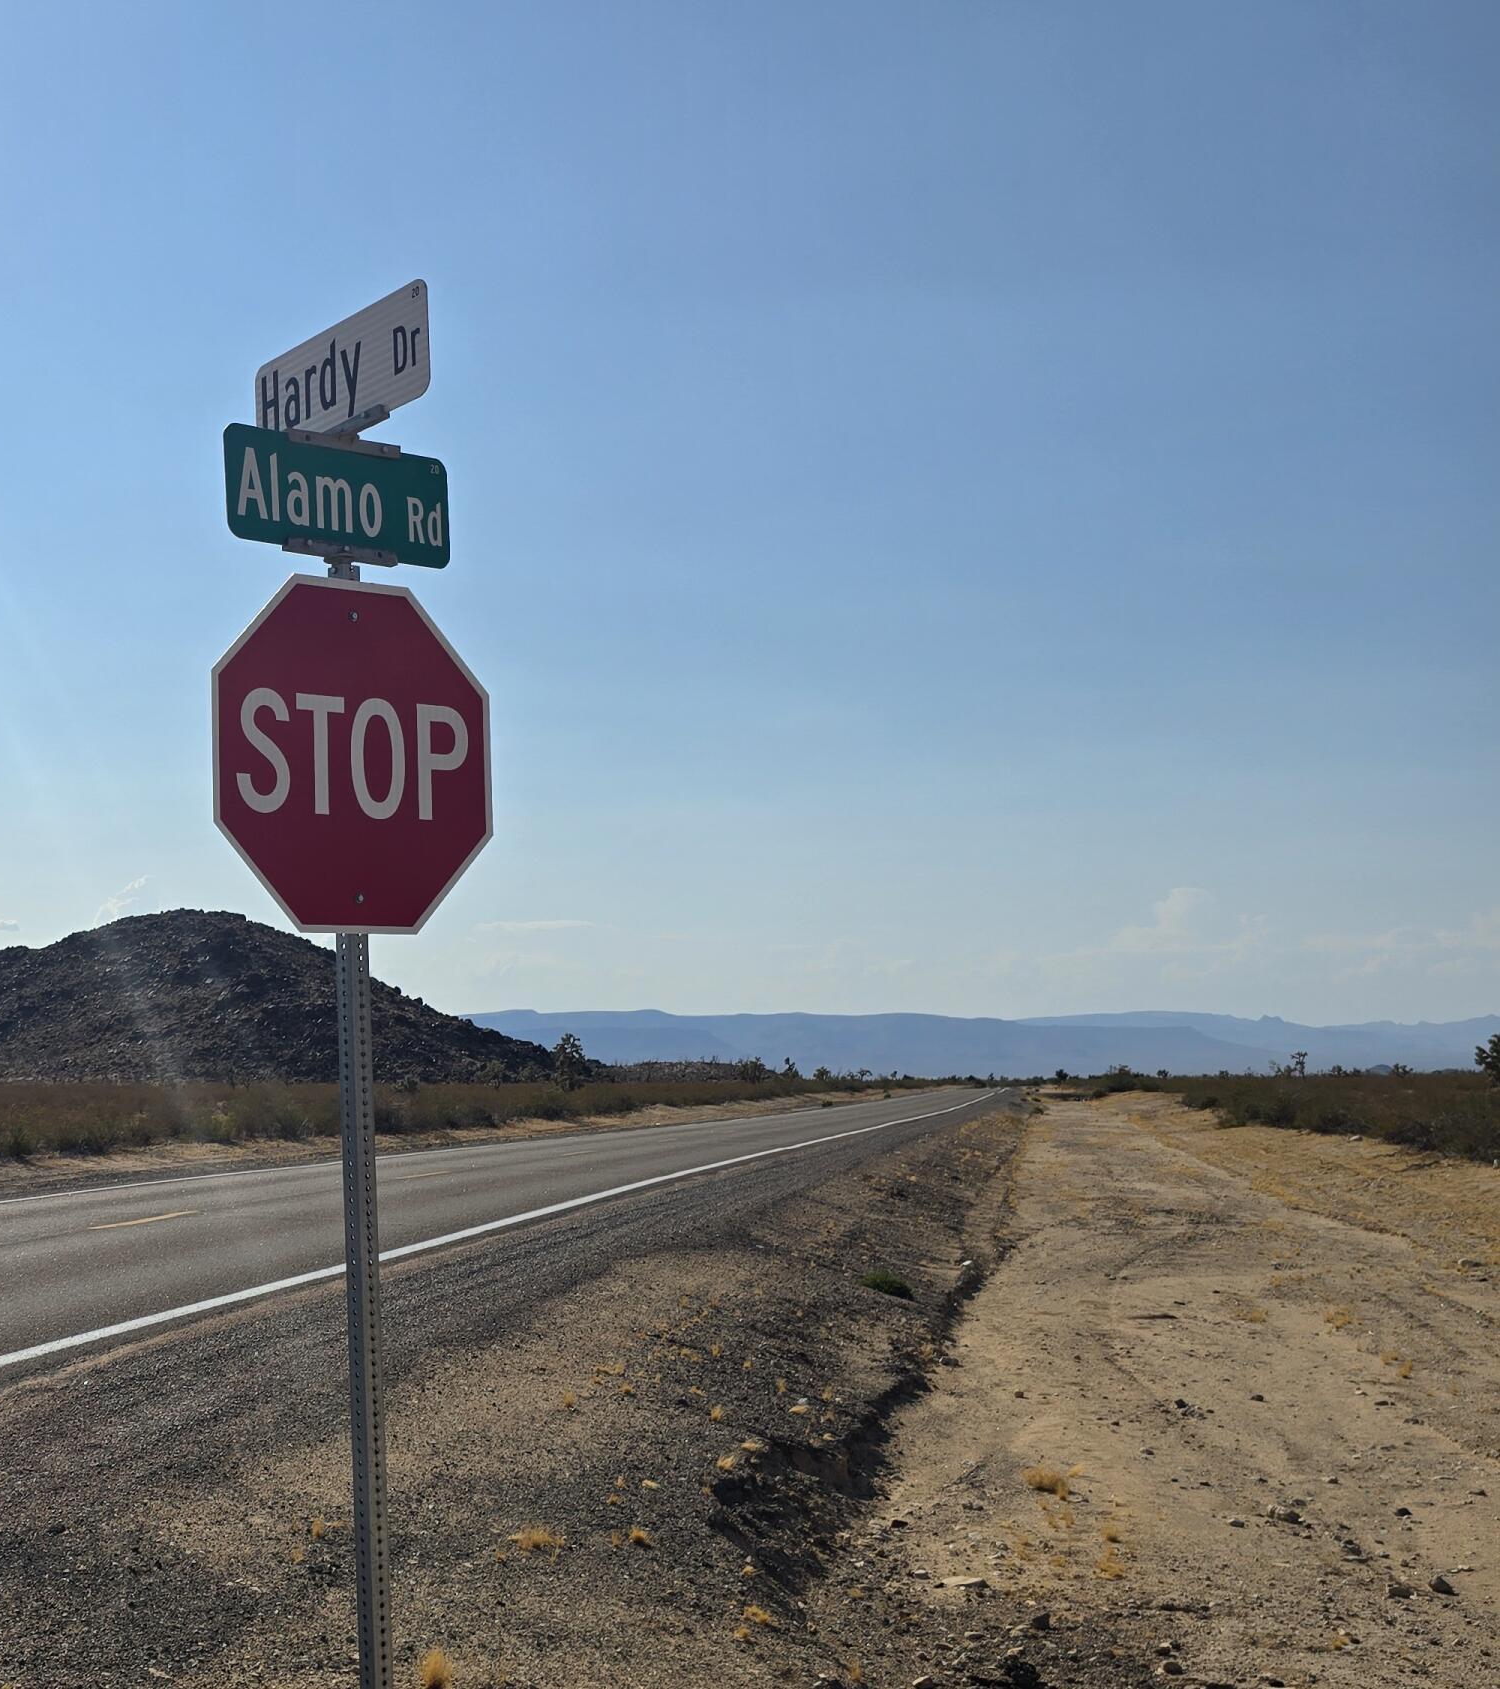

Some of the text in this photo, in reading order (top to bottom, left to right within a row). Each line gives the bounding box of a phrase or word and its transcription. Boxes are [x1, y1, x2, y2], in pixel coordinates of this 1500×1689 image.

[261, 325, 420, 431] Hardy Dr
[237, 446, 443, 547] Alamo Rd
[236, 687, 469, 821] STOP
